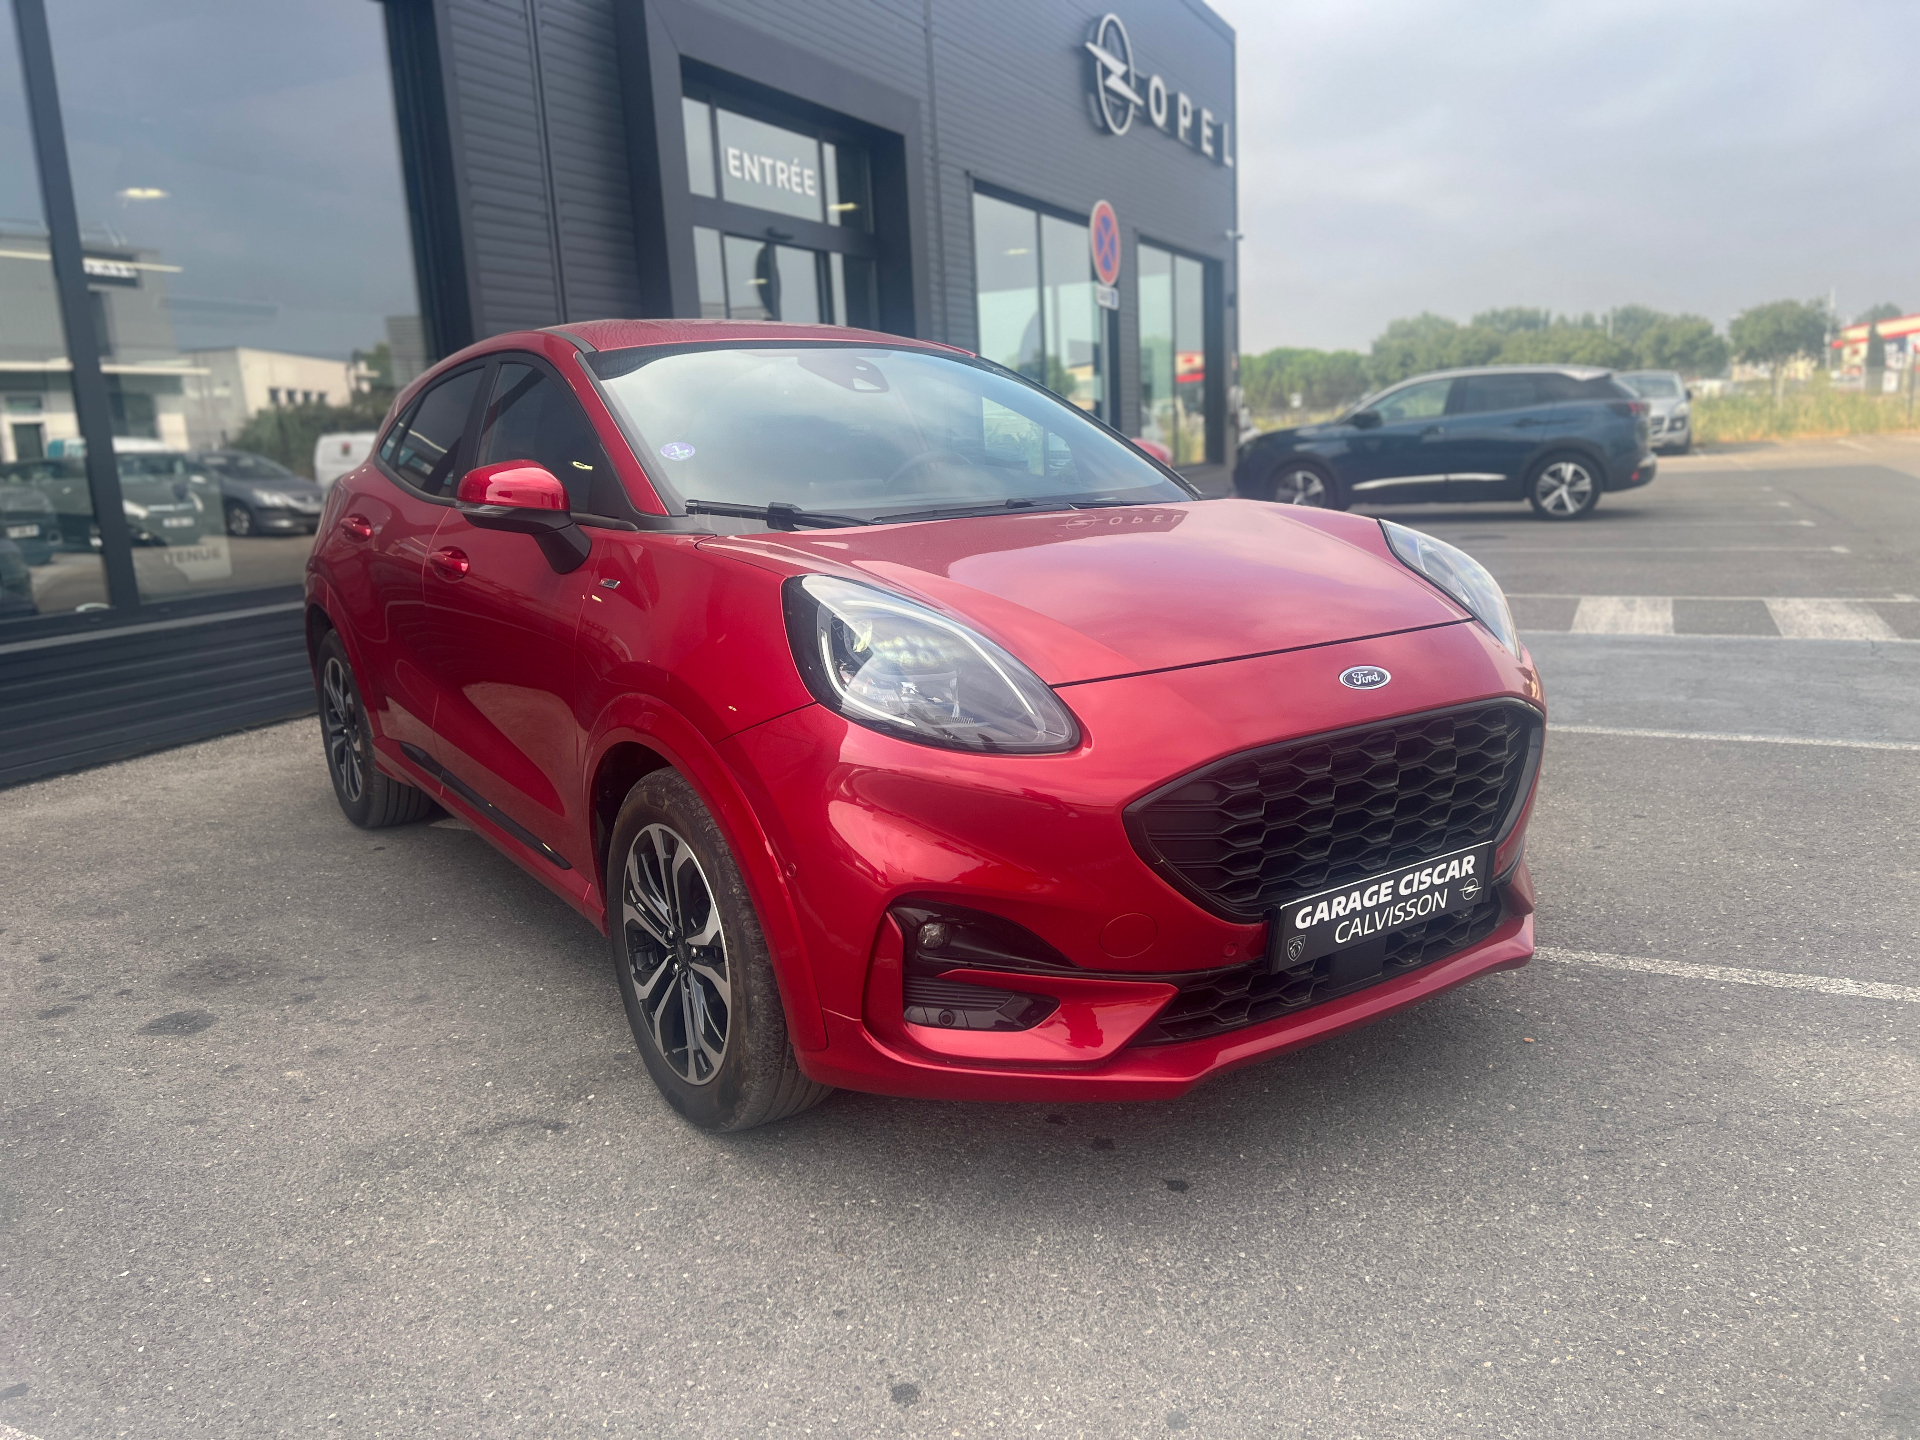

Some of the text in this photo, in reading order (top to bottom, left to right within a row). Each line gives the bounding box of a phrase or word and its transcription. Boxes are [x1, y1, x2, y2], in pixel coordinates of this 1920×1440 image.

[1149, 74, 1234, 168] OPEL
[727, 146, 816, 197] ENTRÉE
[1351, 670, 1380, 685] Ford
[1295, 855, 1476, 929] GARAGE CISCAR
[1335, 888, 1448, 944] CALVISSON
